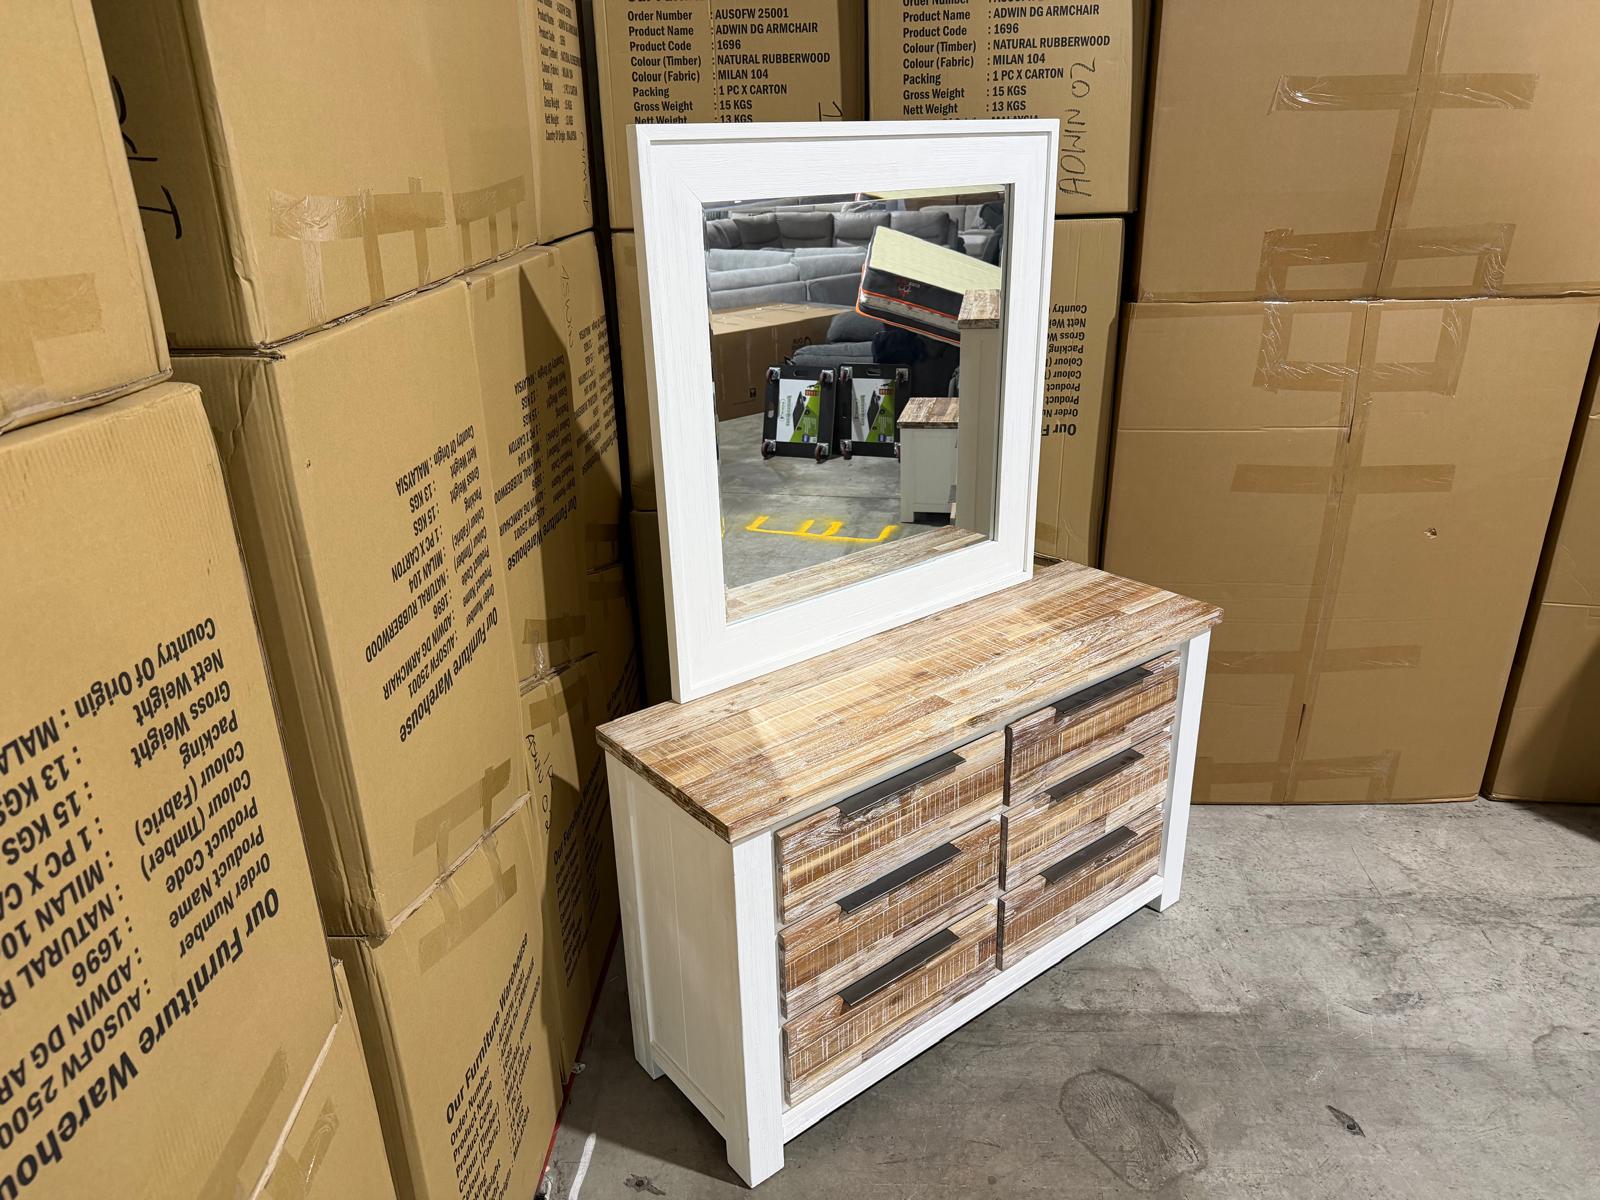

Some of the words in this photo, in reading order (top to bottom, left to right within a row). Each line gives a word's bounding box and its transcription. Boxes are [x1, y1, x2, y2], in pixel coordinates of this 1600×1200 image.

[627, 10, 653, 21] Order
[655, 9, 692, 20] Number
[714, 8, 755, 19] AUSOFW
[758, 7, 788, 18] 25001
[628, 25, 665, 36] Product
[667, 25, 693, 35] Name
[715, 23, 747, 34] ADWIN
[750, 23, 763, 33] DG
[765, 22, 817, 33] ARMCHAIR
[903, 10, 940, 22] Product
[942, 9, 970, 20] Name
[993, 6, 1026, 18] ADWIN
[1029, 6, 1043, 17] DG
[1045, 4, 1099, 16] ARMCHAIR
[903, 26, 940, 38] Product
[942, 25, 966, 36] Code
[994, 22, 1018, 34] 1696
[629, 41, 665, 51] Product
[667, 40, 691, 50] Code
[717, 39, 741, 49] 1696
[630, 56, 660, 66] Colour
[662, 55, 701, 68] (Timber)
[717, 53, 760, 64] NATURAL
[761, 52, 830, 64] RUBBERWOOD
[902, 42, 934, 53] Colour
[936, 40, 976, 54] (Timber)
[993, 37, 1037, 49] NATURAL
[1039, 35, 1110, 48] RUBBERWOOD
[902, 58, 934, 68] Colour
[936, 55, 973, 69] (Fabric)
[992, 53, 1023, 65] MILAN
[1026, 52, 1045, 64] 104
[631, 71, 661, 81] Colour
[663, 70, 699, 83] (Fabric)
[717, 69, 747, 79] MILAN
[750, 68, 768, 79] 104
[632, 86, 669, 98] Packing
[719, 85, 724, 95] 1
[726, 84, 739, 95] PC
[741, 84, 747, 94] X
[749, 83, 786, 94] CARTON
[902, 89, 929, 99] Gross
[931, 87, 964, 100] Weight
[992, 86, 1004, 96] 15
[1006, 85, 1026, 95] KGS
[903, 72, 941, 85] Packing
[992, 70, 998, 81] 1
[1001, 69, 1014, 80] PC
[1015, 69, 1022, 79] X
[1024, 67, 1063, 79] CARTON
[633, 101, 659, 111] Gross
[661, 100, 693, 113] Weight
[719, 99, 731, 110] 15
[733, 99, 752, 109] KGS
[903, 104, 923, 115] Nett
[924, 103, 957, 115] Weight
[992, 101, 1003, 111] 13
[1006, 100, 1025, 111] KGS
[1052, 303, 1087, 314] Country
[1066, 318, 1086, 327] Nett
[1047, 343, 1083, 354] Packing
[1059, 331, 1084, 340] Gross
[1052, 370, 1081, 379] Colour
[1053, 357, 1082, 366] Colour
[1045, 395, 1079, 405] Product
[1046, 382, 1080, 392] Product
[1052, 423, 1076, 436] Our
[1054, 408, 1078, 416] Order
[395, 459, 429, 496] MALAYSIA
[423, 483, 432, 501] 13
[409, 490, 424, 513] KGS
[427, 505, 435, 524] 15
[412, 512, 427, 536] KGS
[425, 532, 434, 551] PC
[434, 527, 439, 542] 1
[391, 545, 419, 582] CARTON
[419, 540, 425, 557] X
[422, 549, 443, 580] MILAN
[507, 529, 543, 570] Warehouse
[408, 569, 421, 593] 104
[417, 571, 446, 609] NATURAL
[432, 592, 448, 619] 1696
[486, 606, 497, 631] Our
[157, 617, 215, 668] Country
[365, 599, 418, 662] RUBBERWOOD
[421, 636, 431, 657] DG
[431, 612, 451, 646] ADWIN
[430, 633, 454, 674] AUSOFW
[452, 622, 486, 675] Furniture
[134, 657, 155, 688] Of
[190, 648, 224, 685] Nett
[382, 647, 420, 700] ARMCHAIR
[407, 663, 429, 698] 25001
[74, 671, 132, 718] Origin
[132, 672, 192, 726] Weight
[189, 680, 230, 720] Gross
[399, 668, 453, 742] Warehouse
[130, 711, 190, 768] Weight
[179, 709, 238, 769] Packing
[40, 754, 69, 790] 13
[200, 740, 244, 788] Colour
[52, 790, 80, 828] 15
[135, 775, 197, 846] (Fabric)
[207, 769, 250, 818] Colour
[0, 813, 51, 865] KGS
[76, 825, 91, 851] 1
[140, 806, 205, 881] (Timber)
[204, 796, 258, 858] Product
[44, 839, 76, 877] PC
[165, 849, 204, 892] Code
[212, 824, 264, 887] Product
[23, 863, 44, 895] X
[235, 852, 270, 898] Order
[34, 859, 104, 932] MILAN
[169, 876, 212, 928] Name
[245, 888, 278, 937] Our
[16, 893, 114, 988] NATURAL
[179, 890, 234, 958] Number
[71, 926, 122, 987] 1696
[66, 955, 131, 1035] ADWIN
[138, 926, 243, 1054] Furniture
[61, 987, 140, 1087] AUSOFW
[446, 1085, 464, 1124] Our
[465, 1010, 500, 1089] Furniture
[499, 932, 528, 1012] Warehouse
[30, 1024, 65, 1068] DG
[450, 1108, 467, 1145] Order
[453, 1111, 477, 1162] Product
